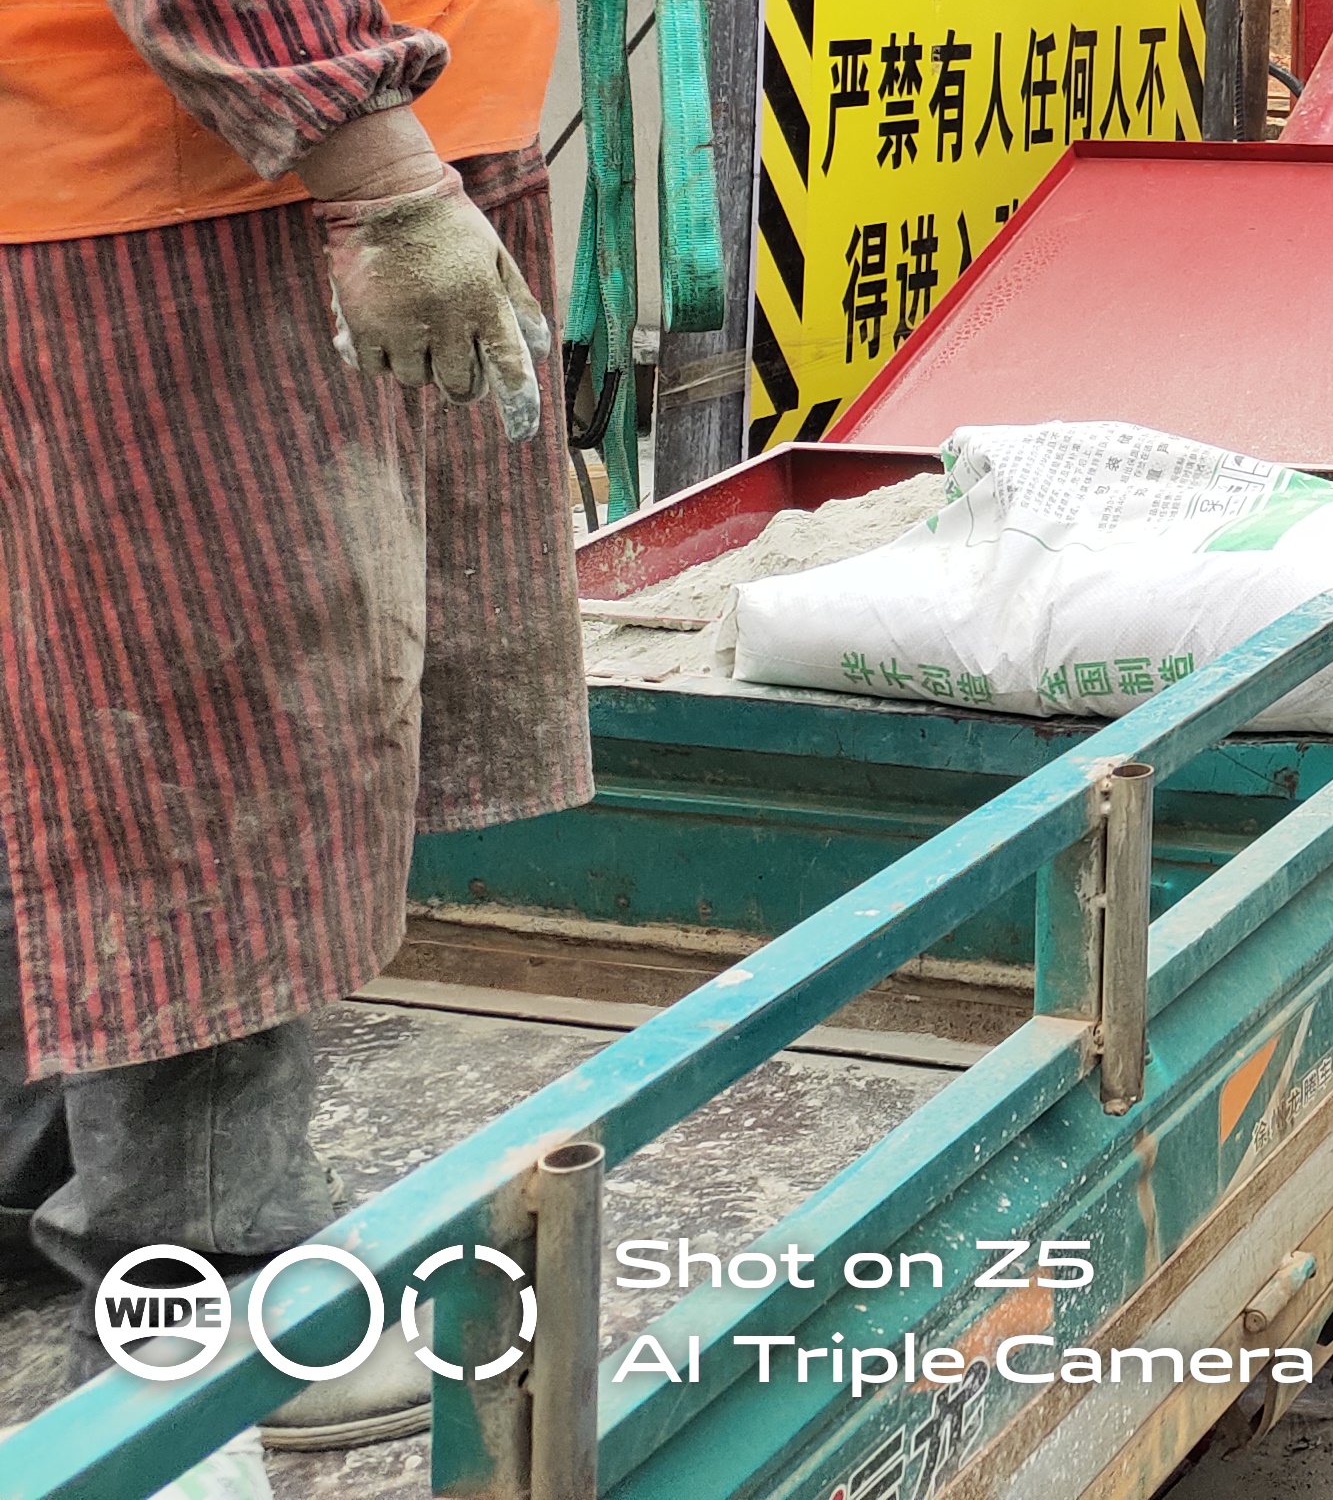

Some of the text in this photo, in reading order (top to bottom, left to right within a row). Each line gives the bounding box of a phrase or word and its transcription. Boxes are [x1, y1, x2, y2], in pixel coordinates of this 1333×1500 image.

[821, 23, 1167, 178] 严禁有人任何人不
[842, 198, 1020, 364] 得进
